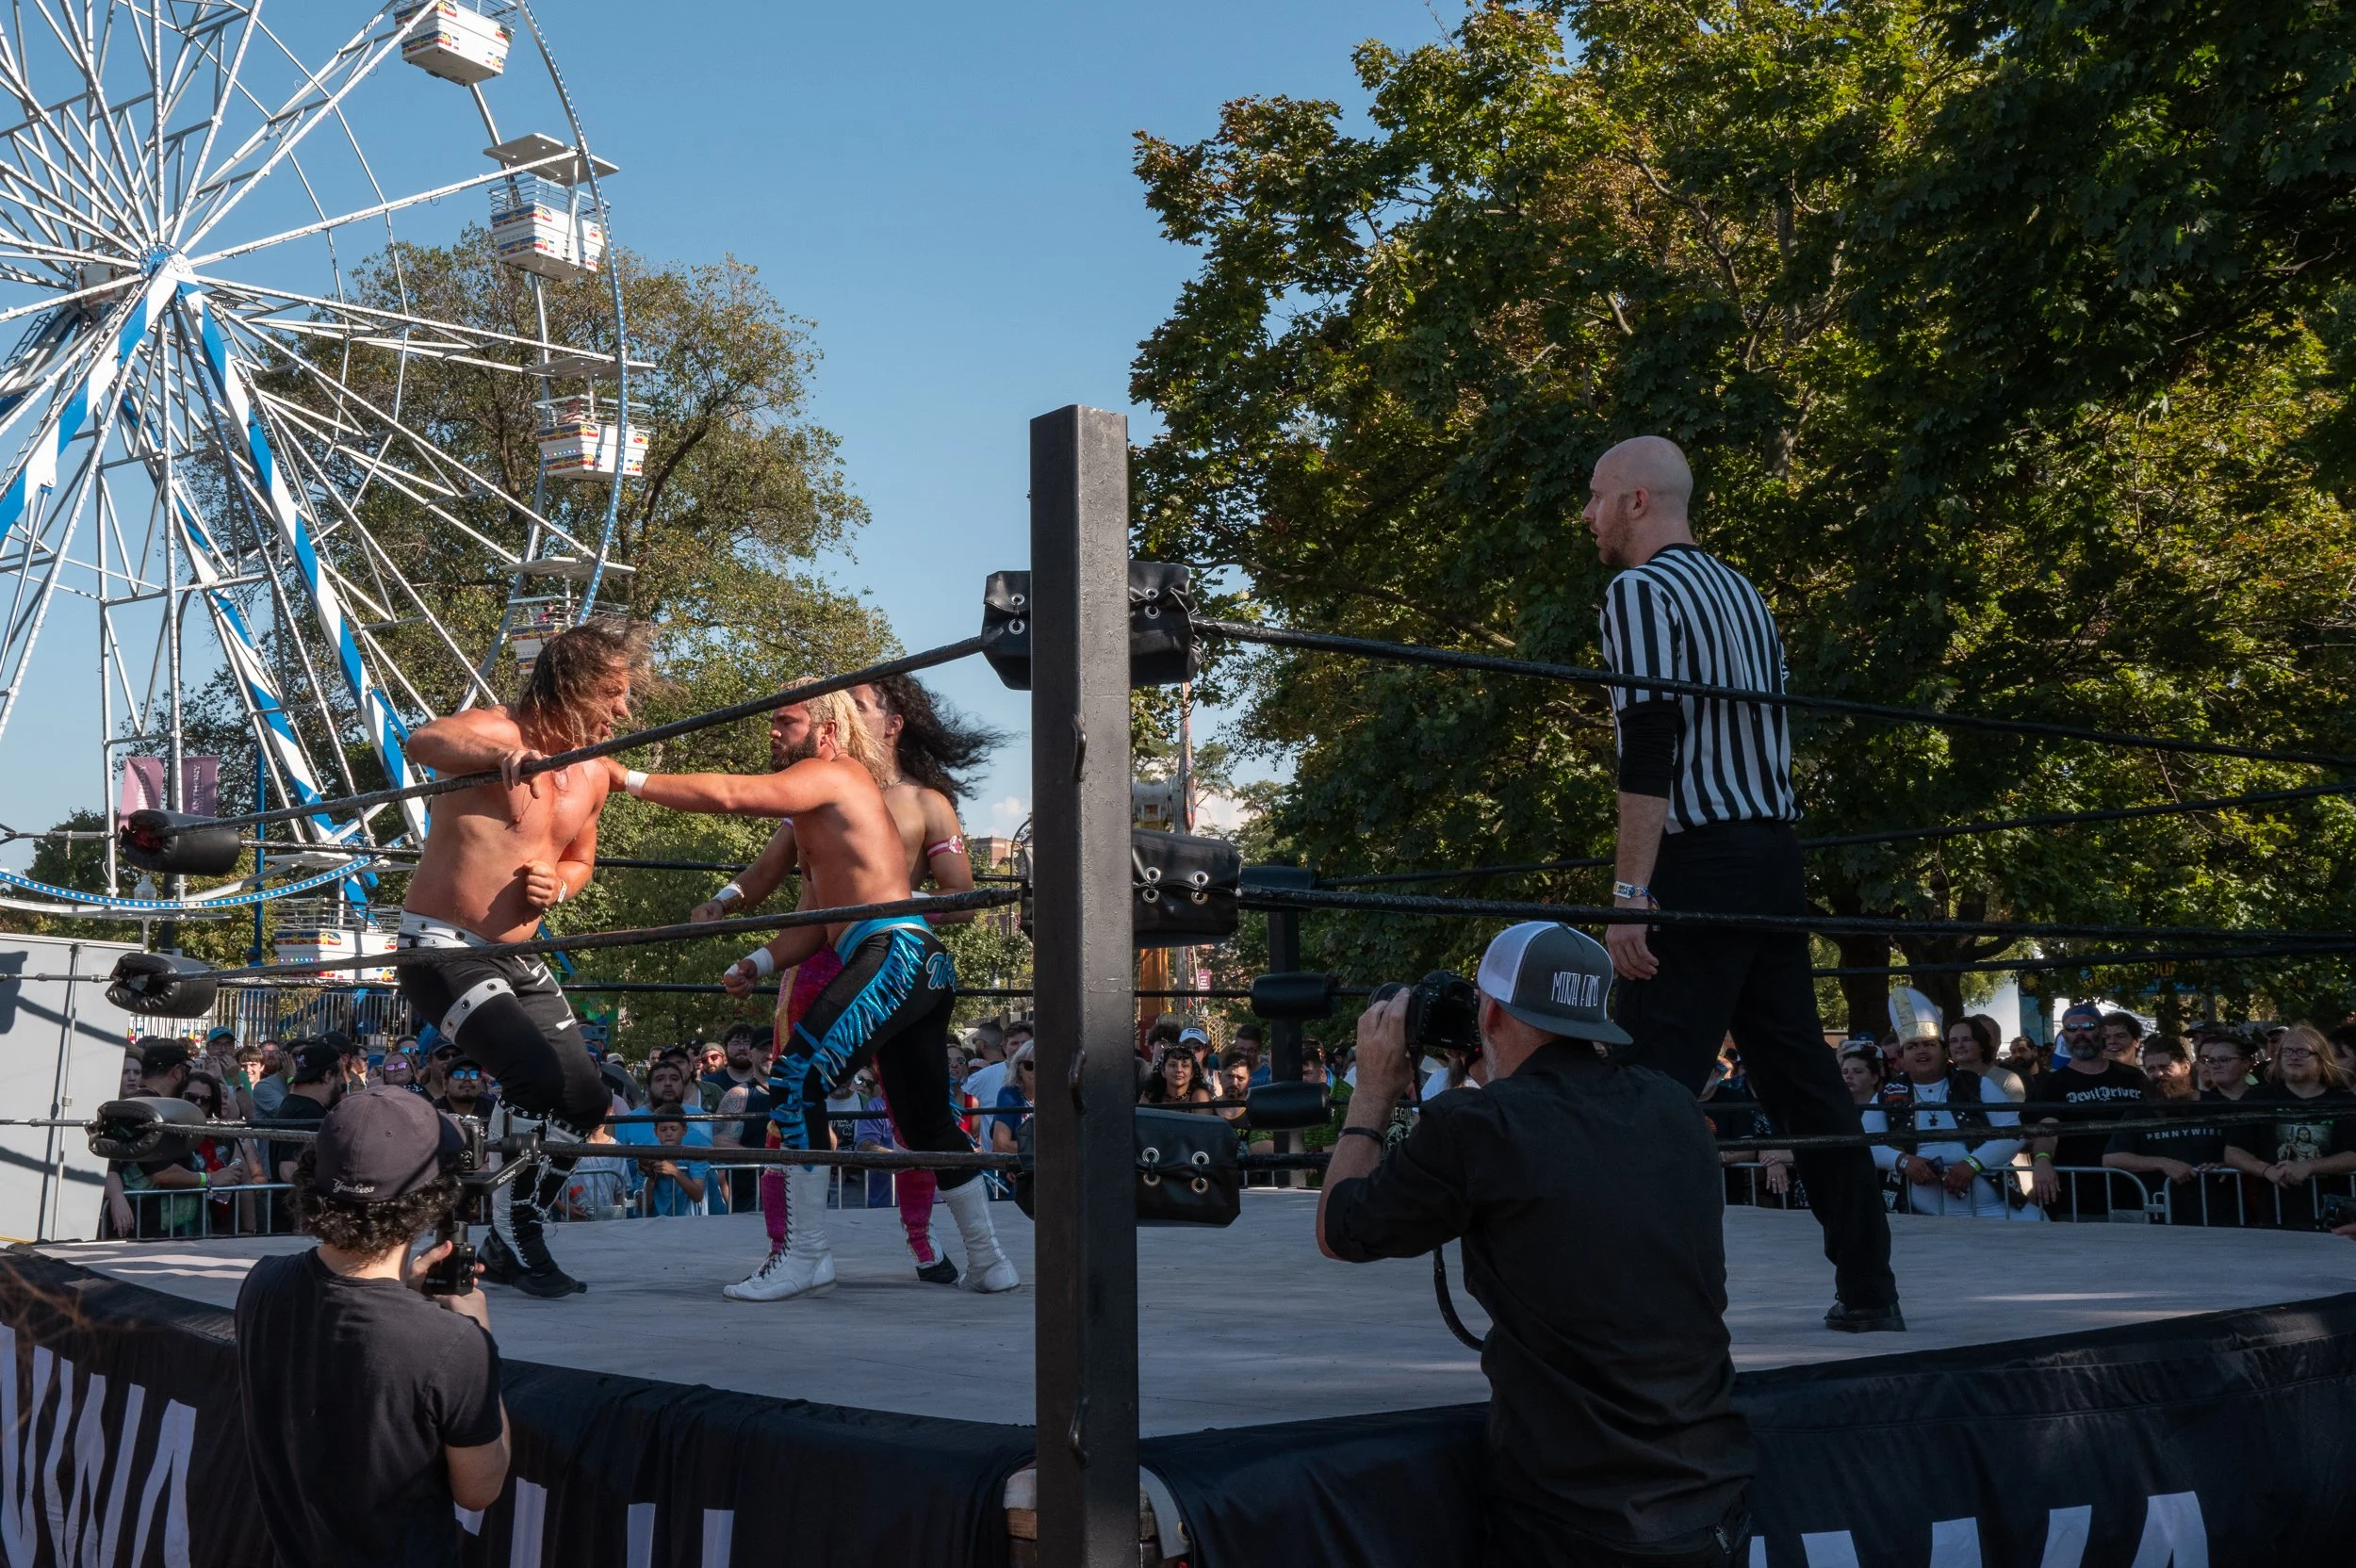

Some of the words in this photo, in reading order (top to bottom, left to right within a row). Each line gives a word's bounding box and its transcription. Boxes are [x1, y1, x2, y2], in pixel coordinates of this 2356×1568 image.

[192, 764, 201, 811] ANTHONY
[2066, 1086, 2143, 1103] DevilDriver
[2145, 1126, 2224, 1141] PENNYWISE
[497, 1168, 516, 1185] RONIN
[332, 1178, 376, 1194] Yankees
